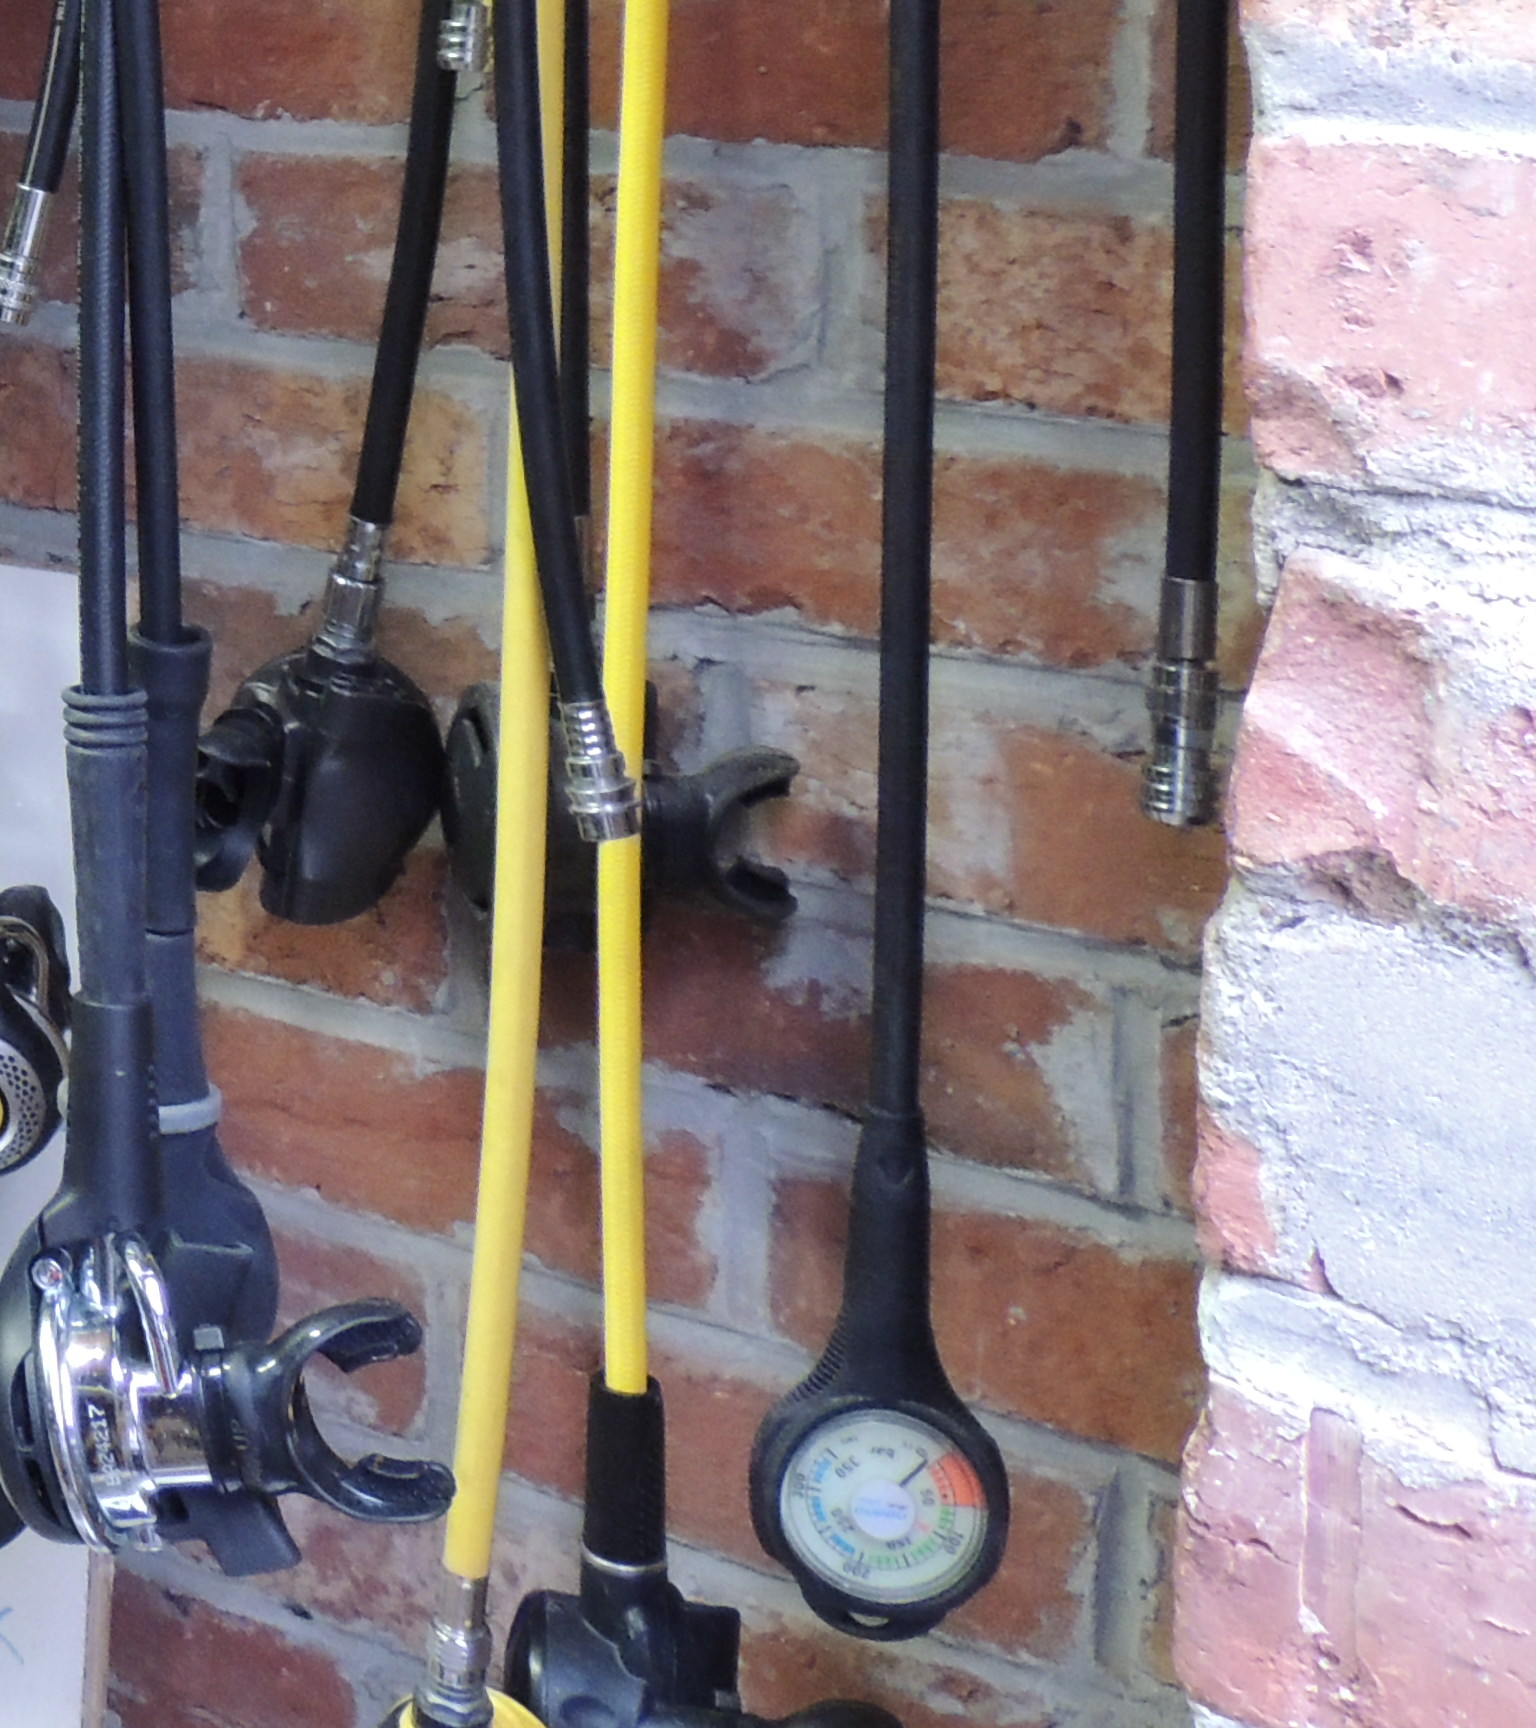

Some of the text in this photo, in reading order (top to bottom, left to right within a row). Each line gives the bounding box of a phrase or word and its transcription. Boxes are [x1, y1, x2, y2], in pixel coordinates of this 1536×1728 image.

[869, 1445, 896, 1459] bar
[834, 1455, 860, 1479] 350
[792, 1473, 806, 1500] 300
[919, 1488, 936, 1506] 50
[942, 1531, 964, 1556] 100
[842, 1562, 872, 1580] 200
